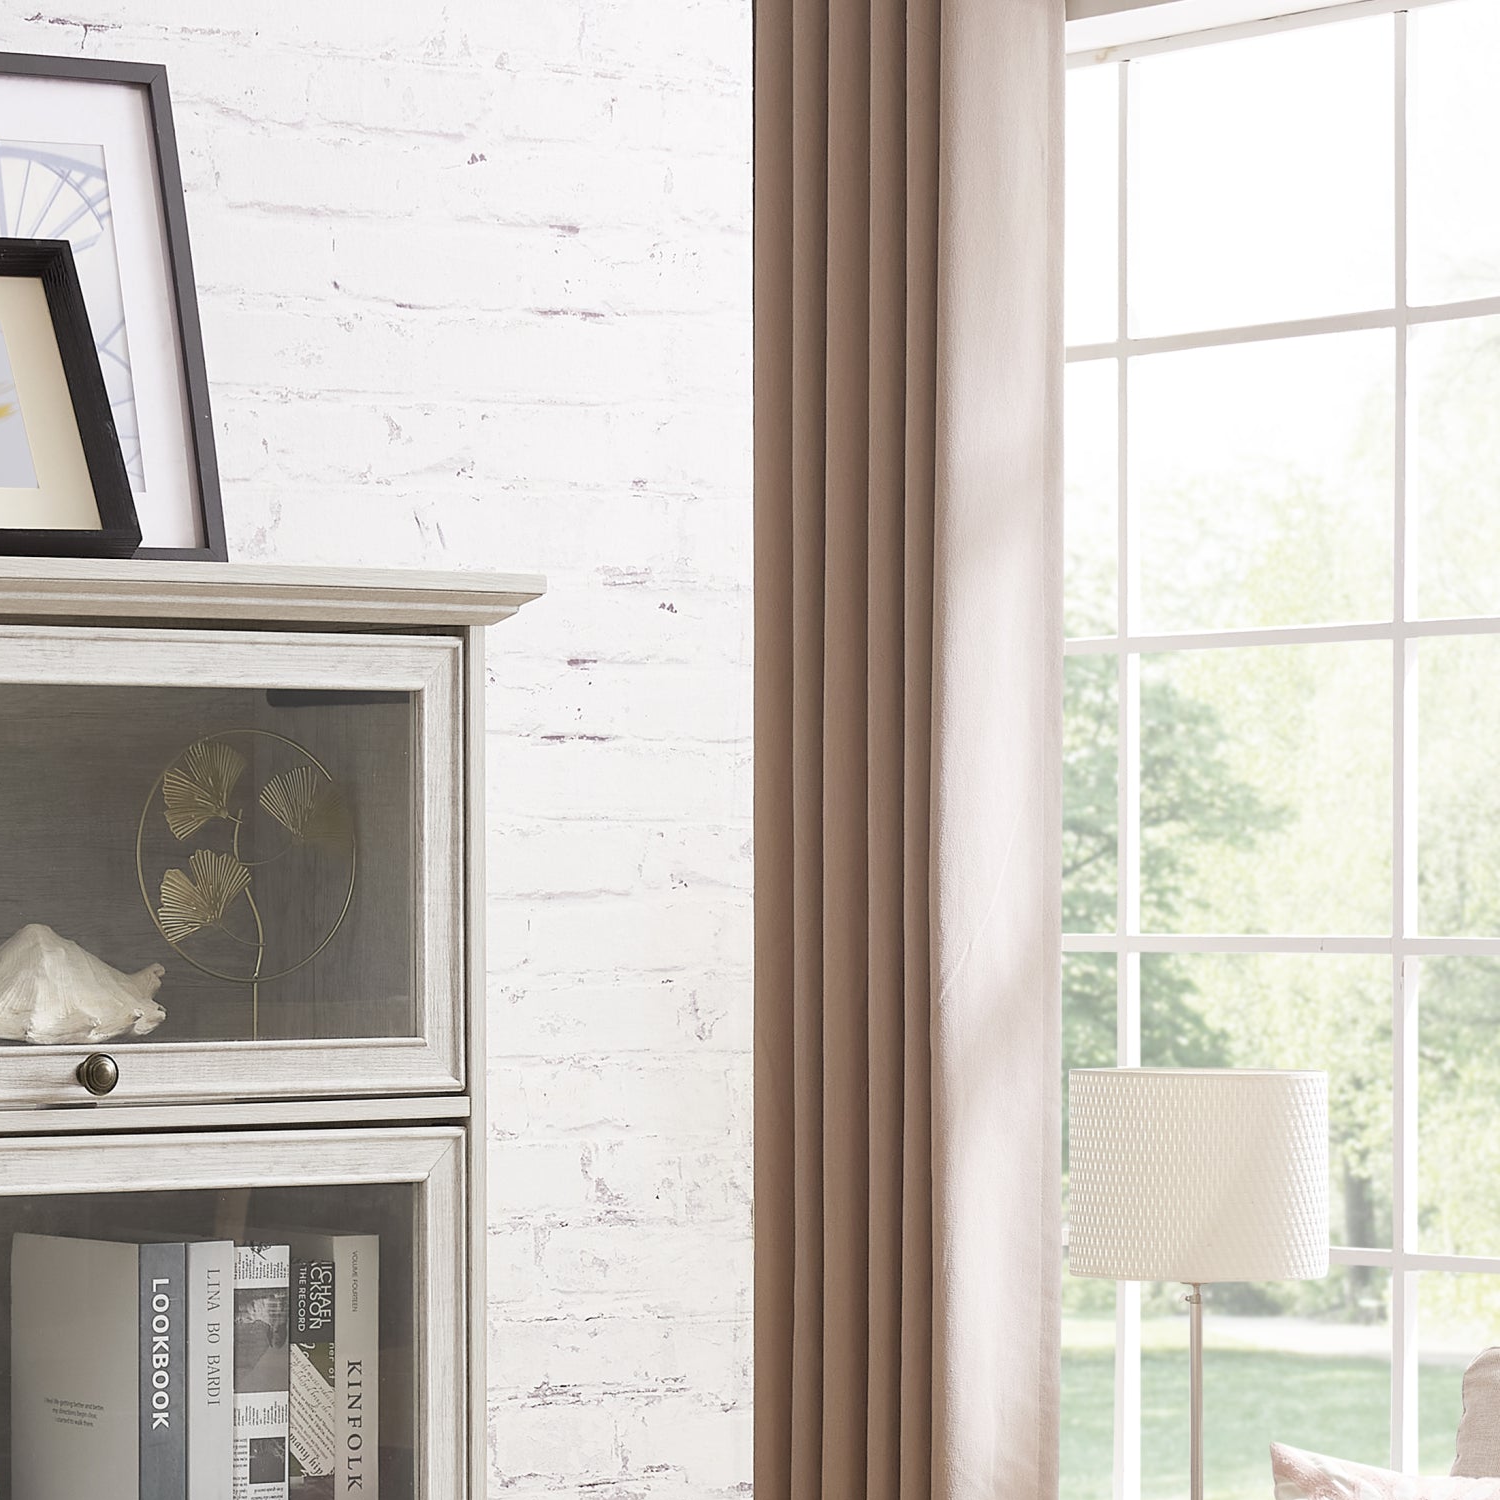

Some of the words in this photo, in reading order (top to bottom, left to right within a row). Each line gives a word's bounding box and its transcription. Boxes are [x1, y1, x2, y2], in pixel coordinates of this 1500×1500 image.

[207, 1268, 220, 1311] LINA
[299, 1267, 307, 1285] THE
[298, 1287, 306, 1332] RECORD
[151, 1278, 170, 1430] LOOKBOOK
[207, 1322, 220, 1344] BO
[207, 1354, 220, 1406] BARDI
[346, 1359, 363, 1492] KINFOLK
